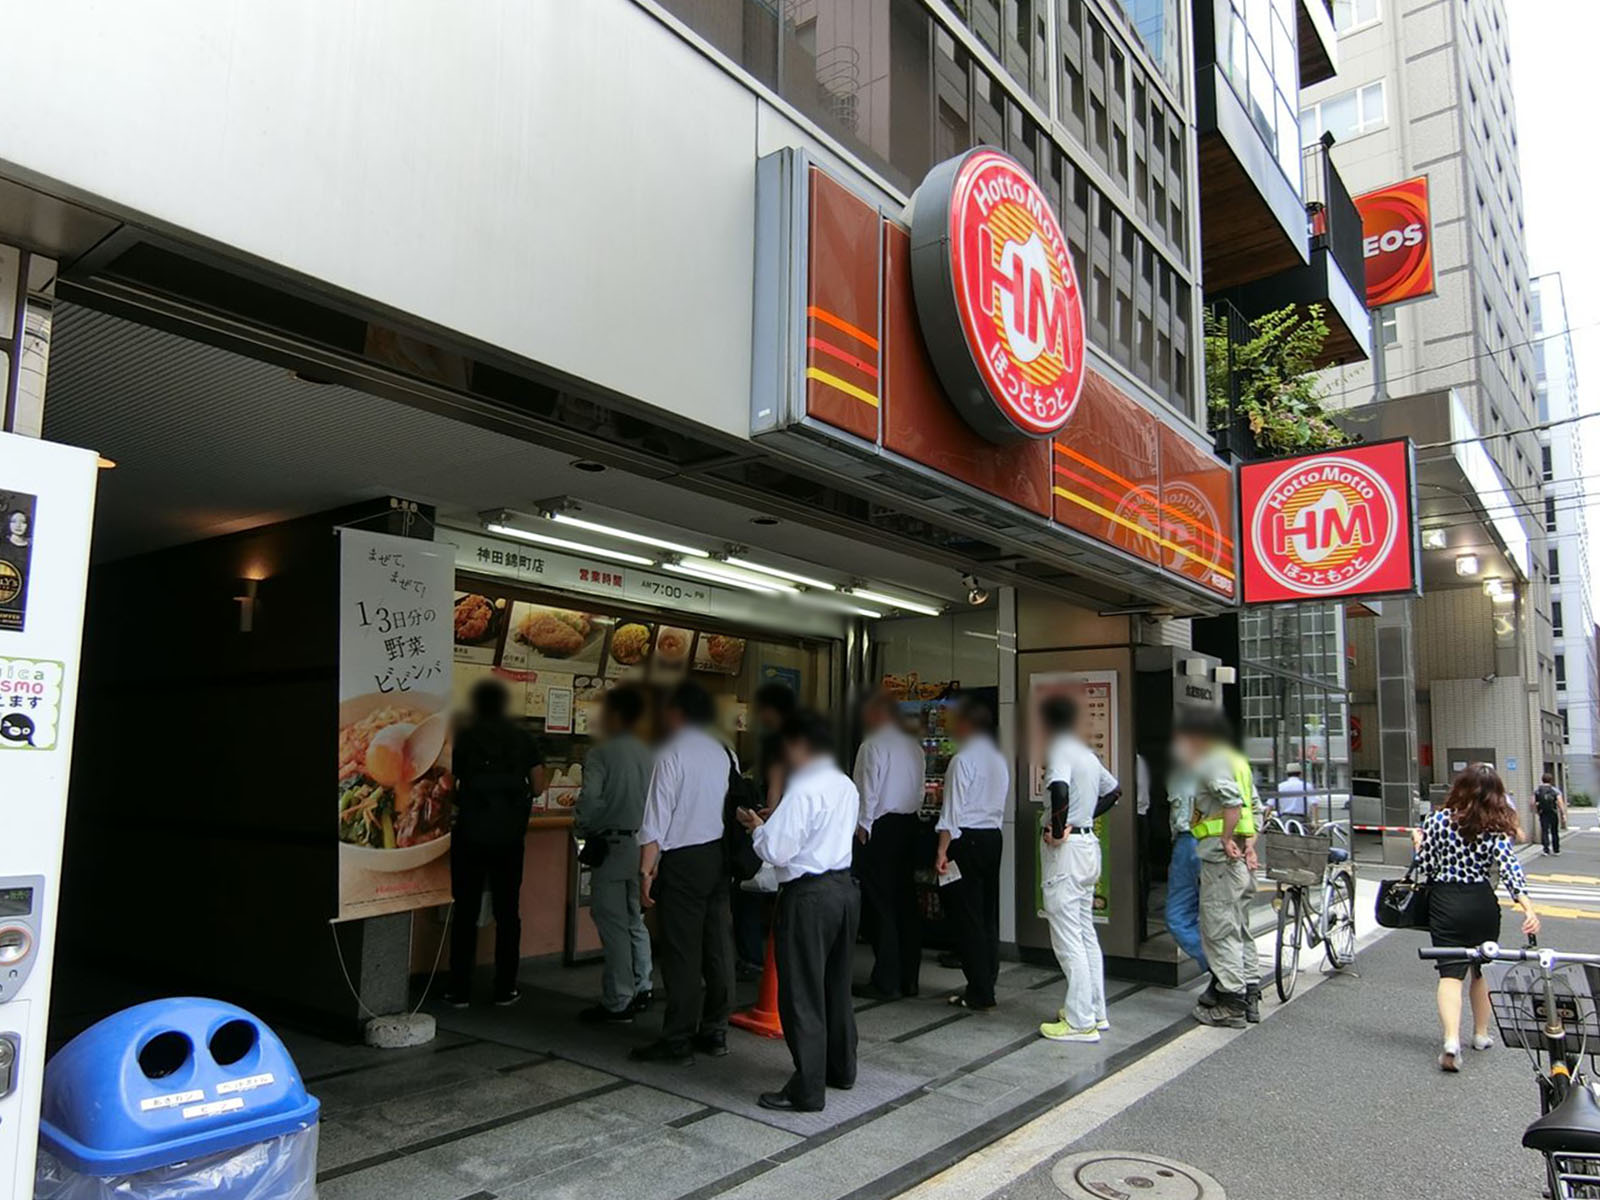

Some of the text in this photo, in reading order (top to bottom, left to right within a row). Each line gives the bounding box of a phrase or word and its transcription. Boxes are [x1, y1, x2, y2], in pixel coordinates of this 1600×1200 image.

[973, 175, 1073, 289] Hotto Motto
[1363, 223, 1423, 259] EOS
[978, 223, 1074, 373] HM
[990, 342, 1069, 418] ほっともっと
[1268, 466, 1375, 510] Hotto Motto
[1272, 502, 1375, 556] HM
[476, 546, 545, 574] 神田錦町店
[1283, 556, 1368, 585] ほっともっと
[579, 568, 623, 587] 営業時間
[356, 601, 436, 634] 13日分の
[384, 635, 425, 661] 野菜
[0, 665, 45, 681] ica
[374, 660, 442, 694] ビビンバ
